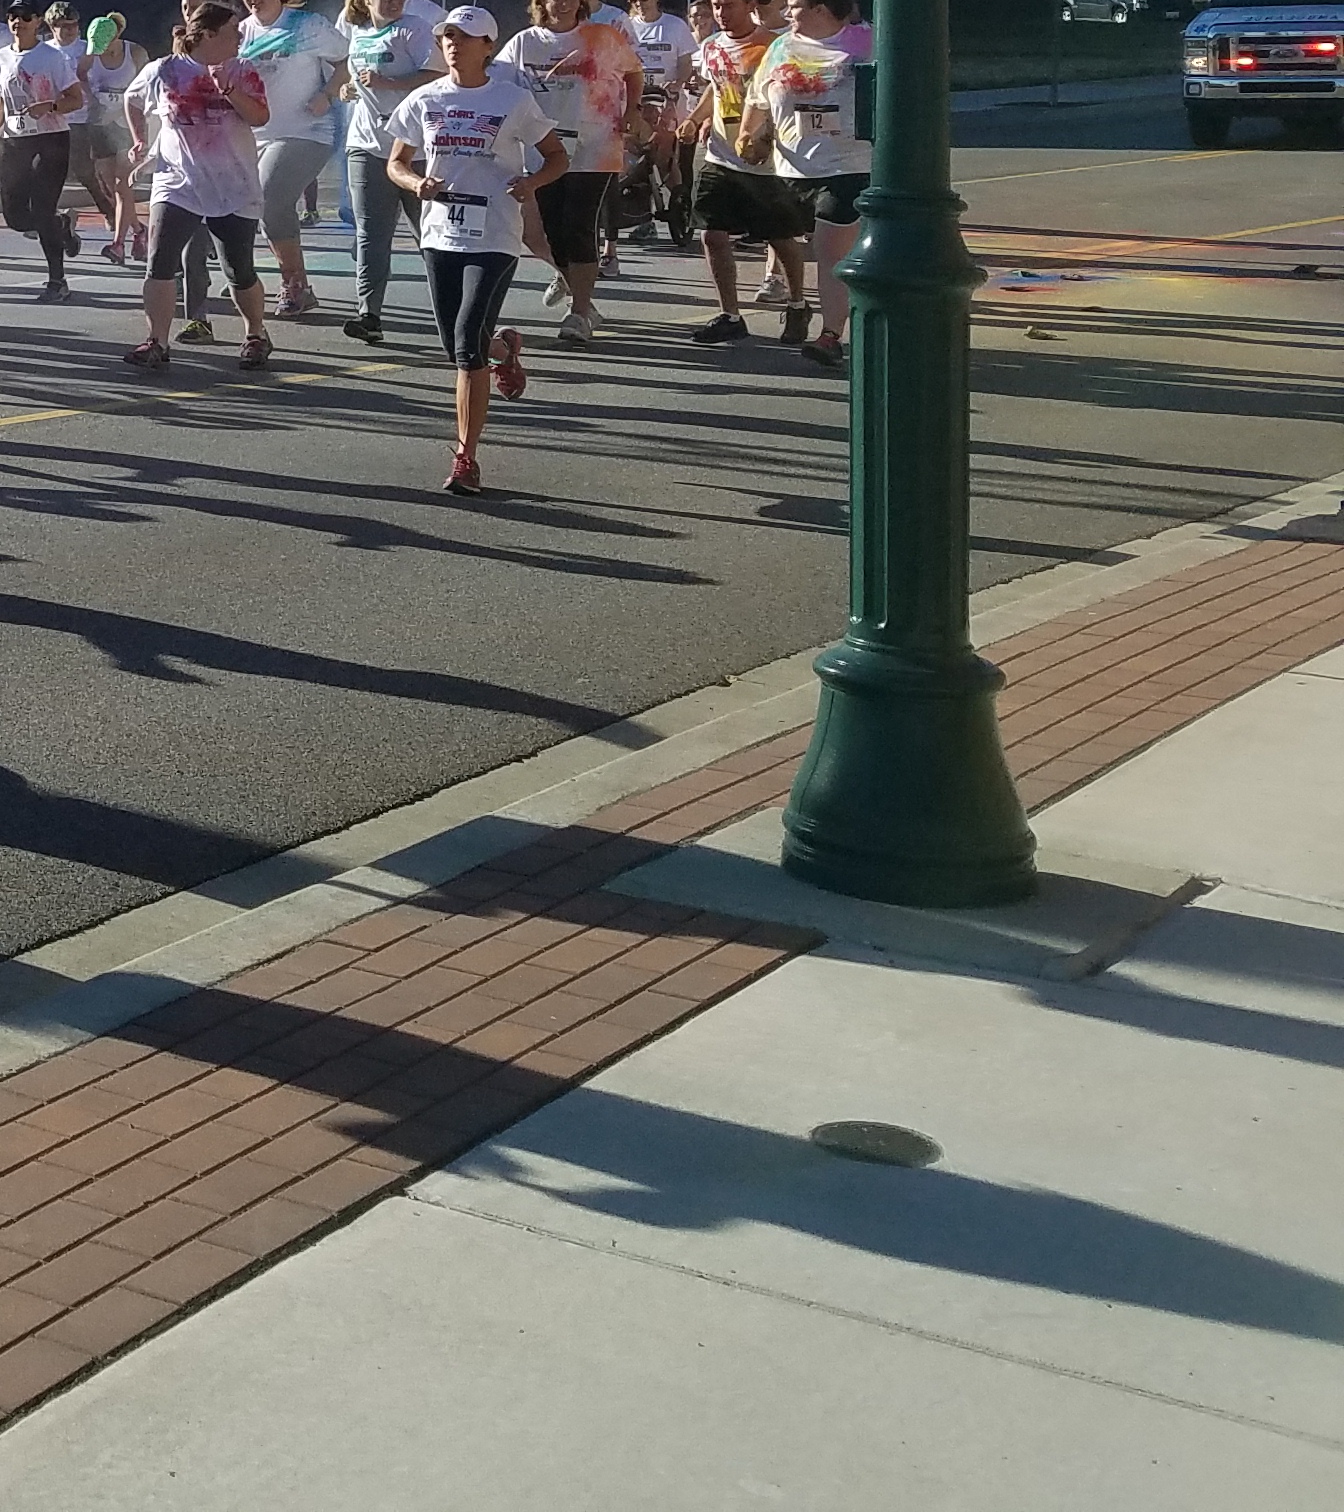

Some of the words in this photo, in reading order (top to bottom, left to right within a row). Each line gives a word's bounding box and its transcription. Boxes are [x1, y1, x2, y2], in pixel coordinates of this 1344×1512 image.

[447, 109, 476, 119] CHRIS
[810, 113, 823, 130] 12
[431, 133, 486, 149] Johnson
[447, 205, 465, 226] 44
